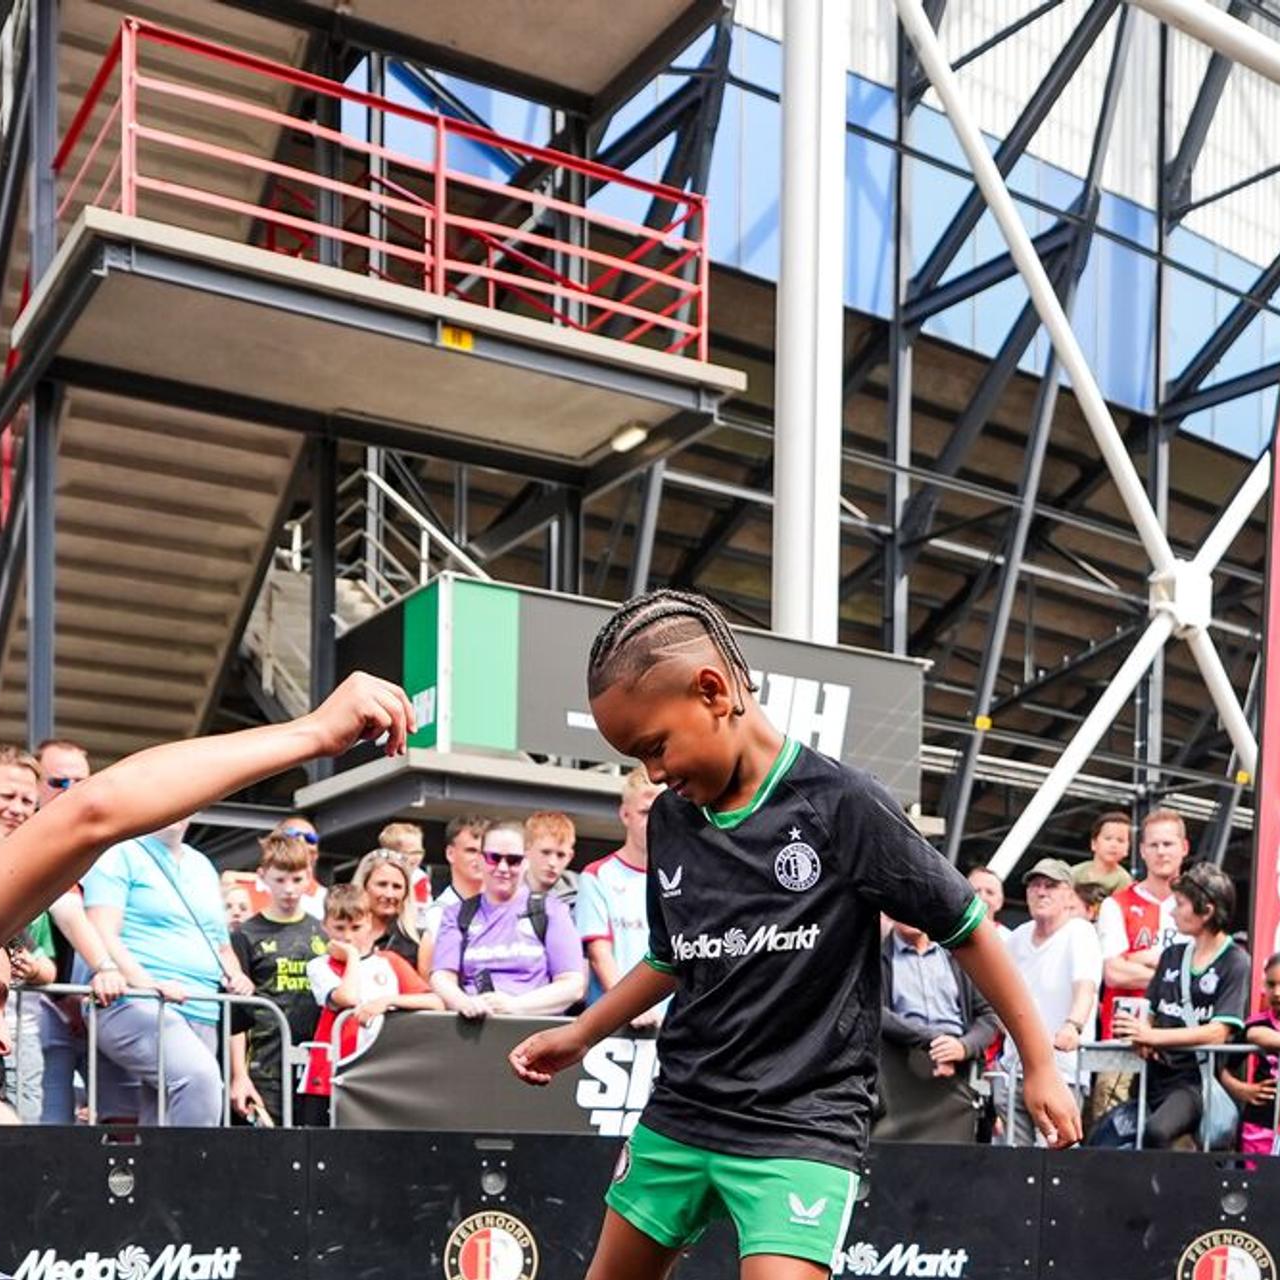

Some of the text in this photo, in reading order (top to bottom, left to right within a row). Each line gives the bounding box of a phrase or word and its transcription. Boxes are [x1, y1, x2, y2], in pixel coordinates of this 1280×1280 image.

[743, 923, 819, 955] Markt
[276, 957, 306, 975] Eur
[454, 1215, 530, 1248] FEYENOORD
[872, 1242, 968, 1278] Markt
[1187, 1233, 1269, 1269] FEYENOORD
